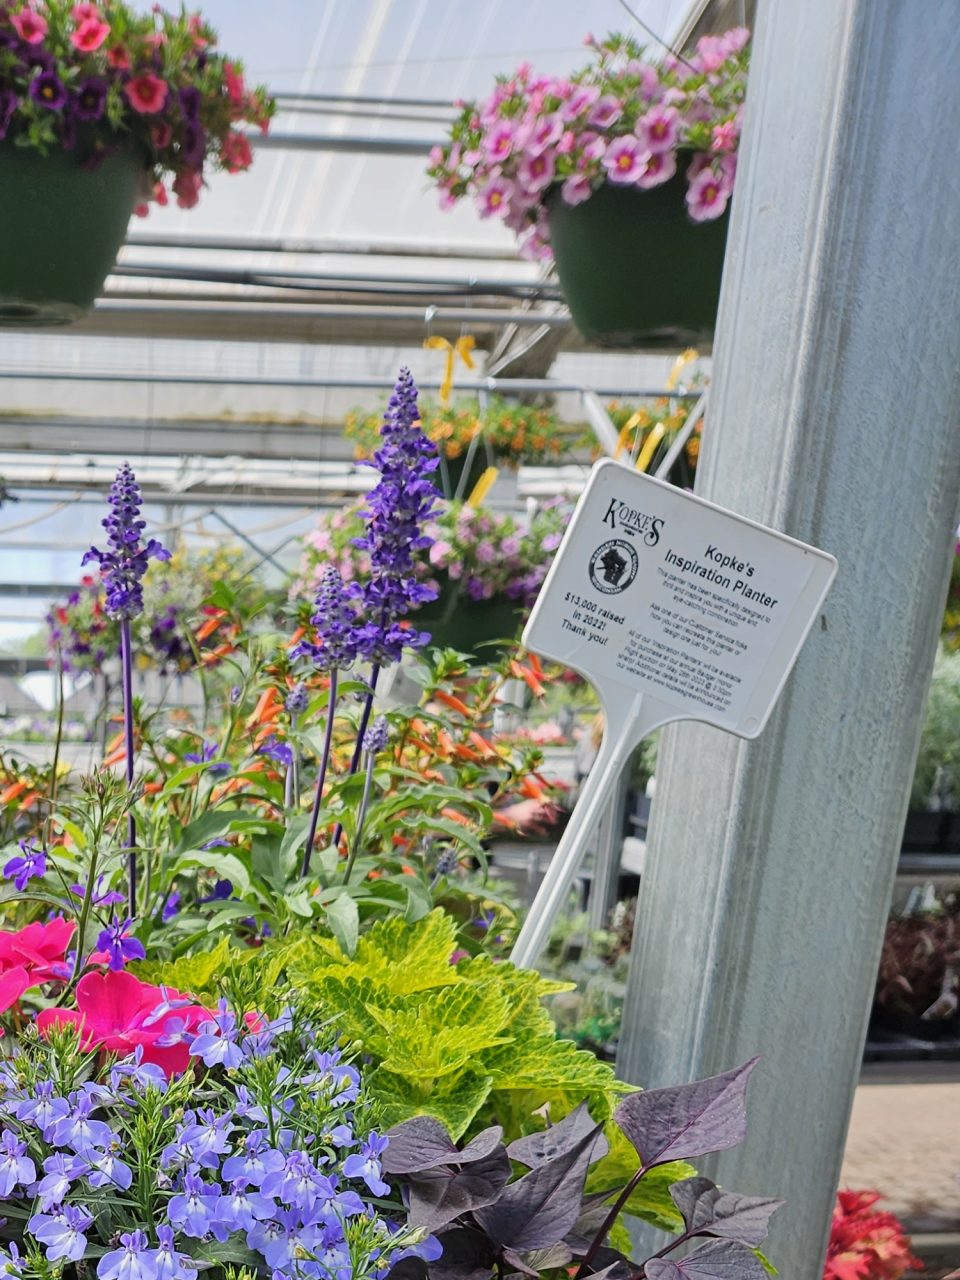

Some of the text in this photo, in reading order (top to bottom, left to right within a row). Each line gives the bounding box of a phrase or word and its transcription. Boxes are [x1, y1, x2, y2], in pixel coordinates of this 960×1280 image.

[602, 498, 665, 547] KOPKE'S
[705, 545, 755, 577] Kopke's
[665, 549, 731, 588] Inspiration
[733, 579, 778, 608] Planter
[565, 592, 625, 624] $13,000 raised
[583, 615, 606, 630] 2022!
[562, 619, 608, 646] Thank you!
[705, 680, 712, 690] @
